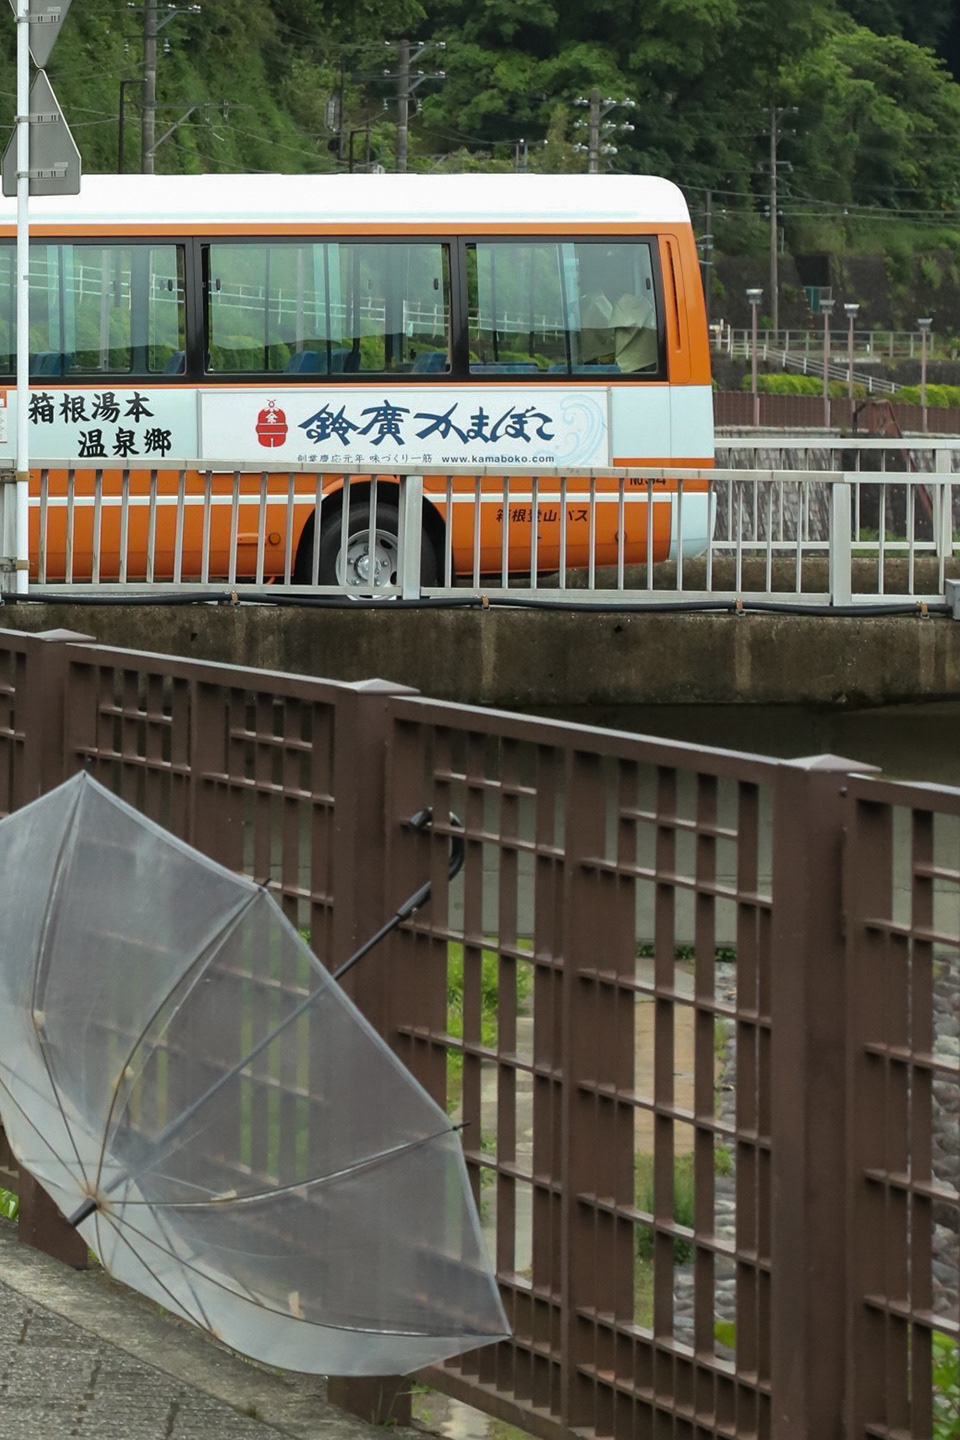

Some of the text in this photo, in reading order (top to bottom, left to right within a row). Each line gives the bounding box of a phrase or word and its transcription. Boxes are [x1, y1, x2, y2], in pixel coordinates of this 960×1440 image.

[28, 392, 155, 425] 箱根湯本
[297, 399, 556, 447] 鈴廣かまぼこ
[78, 427, 172, 458] 温泉郷
[369, 453, 433, 464] 味づくり一筋
[441, 454, 555, 463] www.kamaboko.com
